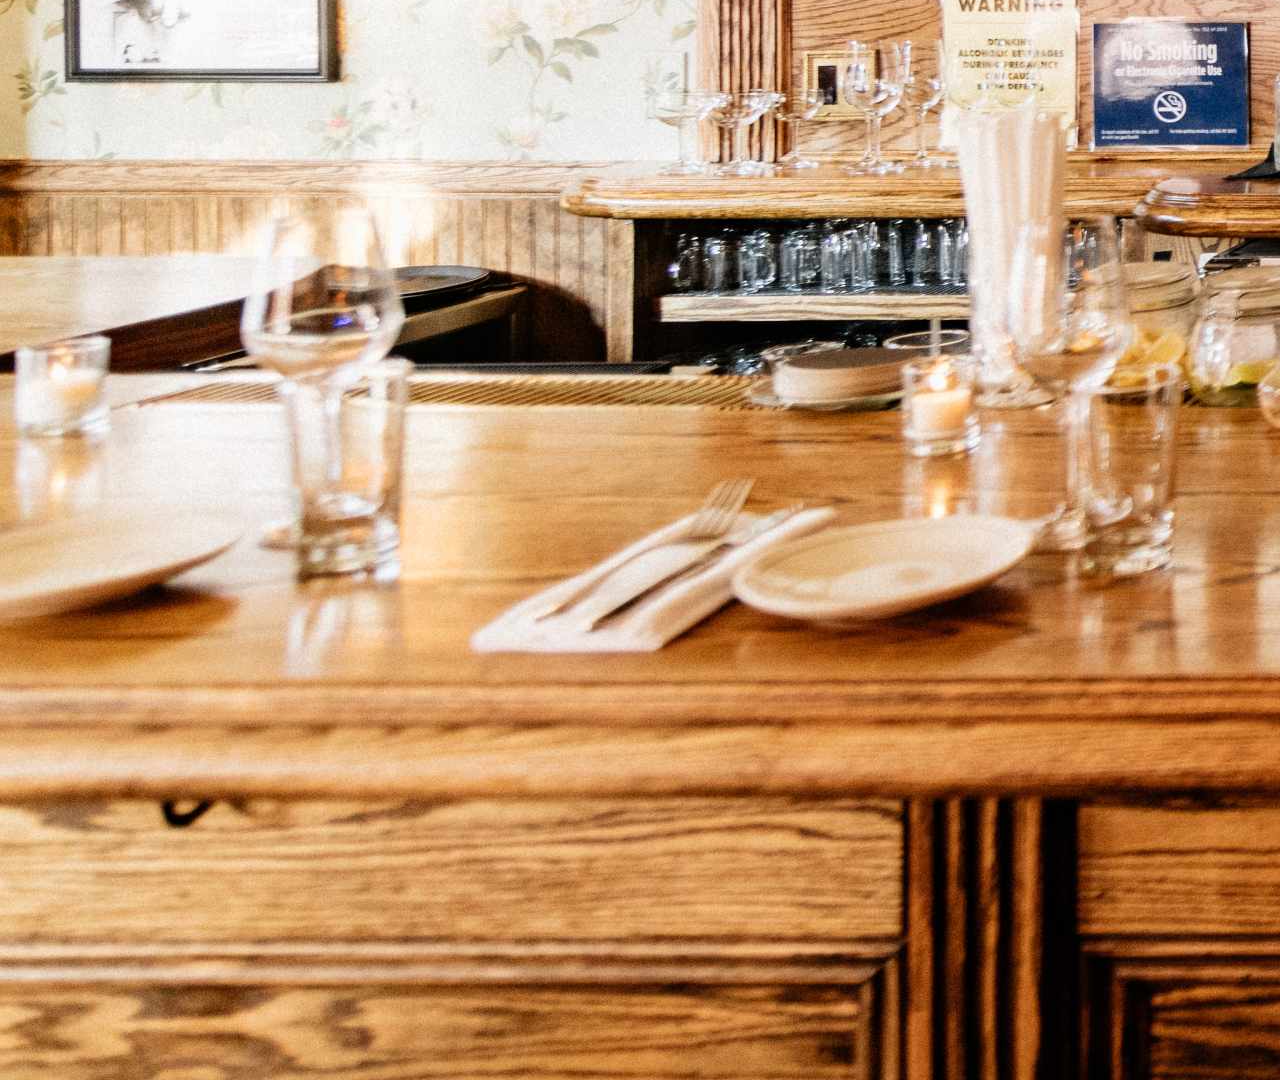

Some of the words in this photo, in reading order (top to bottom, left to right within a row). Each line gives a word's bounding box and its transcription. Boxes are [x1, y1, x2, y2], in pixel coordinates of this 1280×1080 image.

[1121, 41, 1143, 61] No
[1147, 39, 1218, 64] Smoking
[1207, 65, 1223, 76] Use
